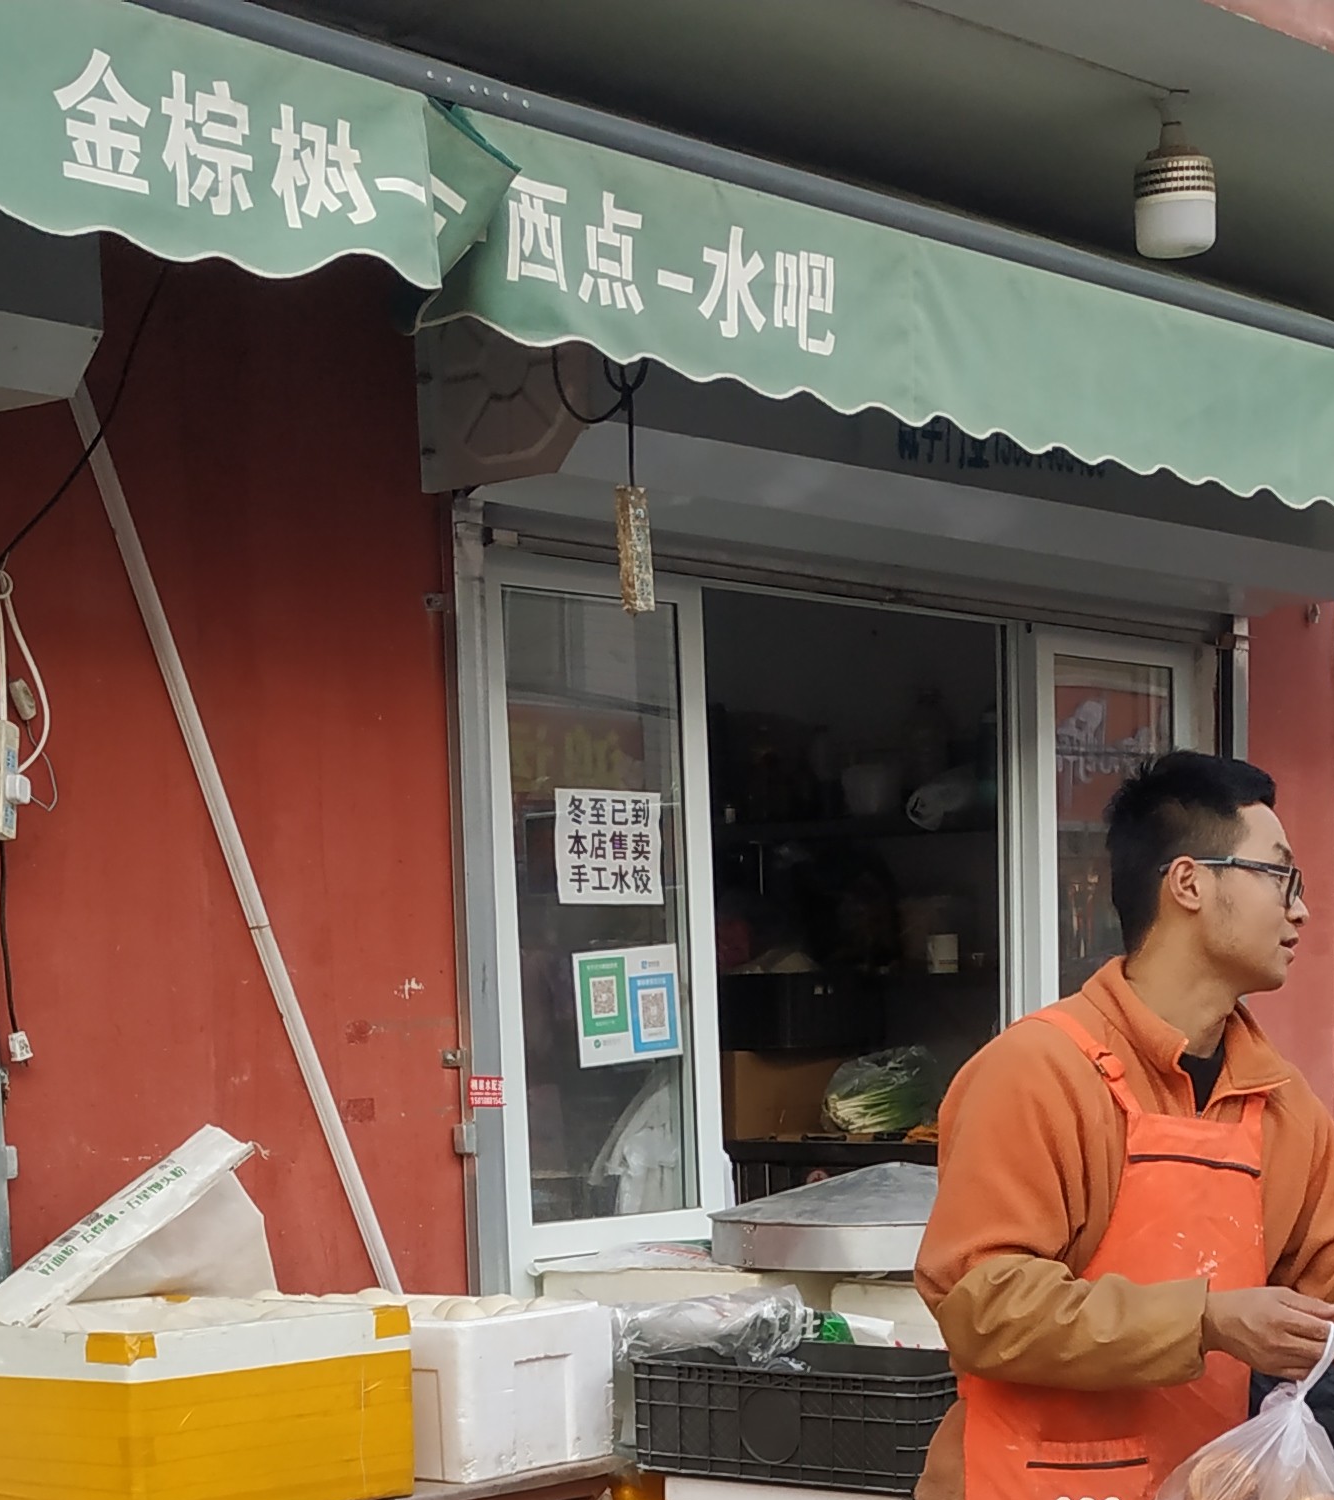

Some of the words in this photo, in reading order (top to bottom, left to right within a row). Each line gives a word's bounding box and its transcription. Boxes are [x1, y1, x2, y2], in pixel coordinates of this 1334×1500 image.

[567, 795, 651, 828] 冬至已到
[567, 829, 651, 861] 本店售卖
[568, 863, 653, 896] 手工水饺
